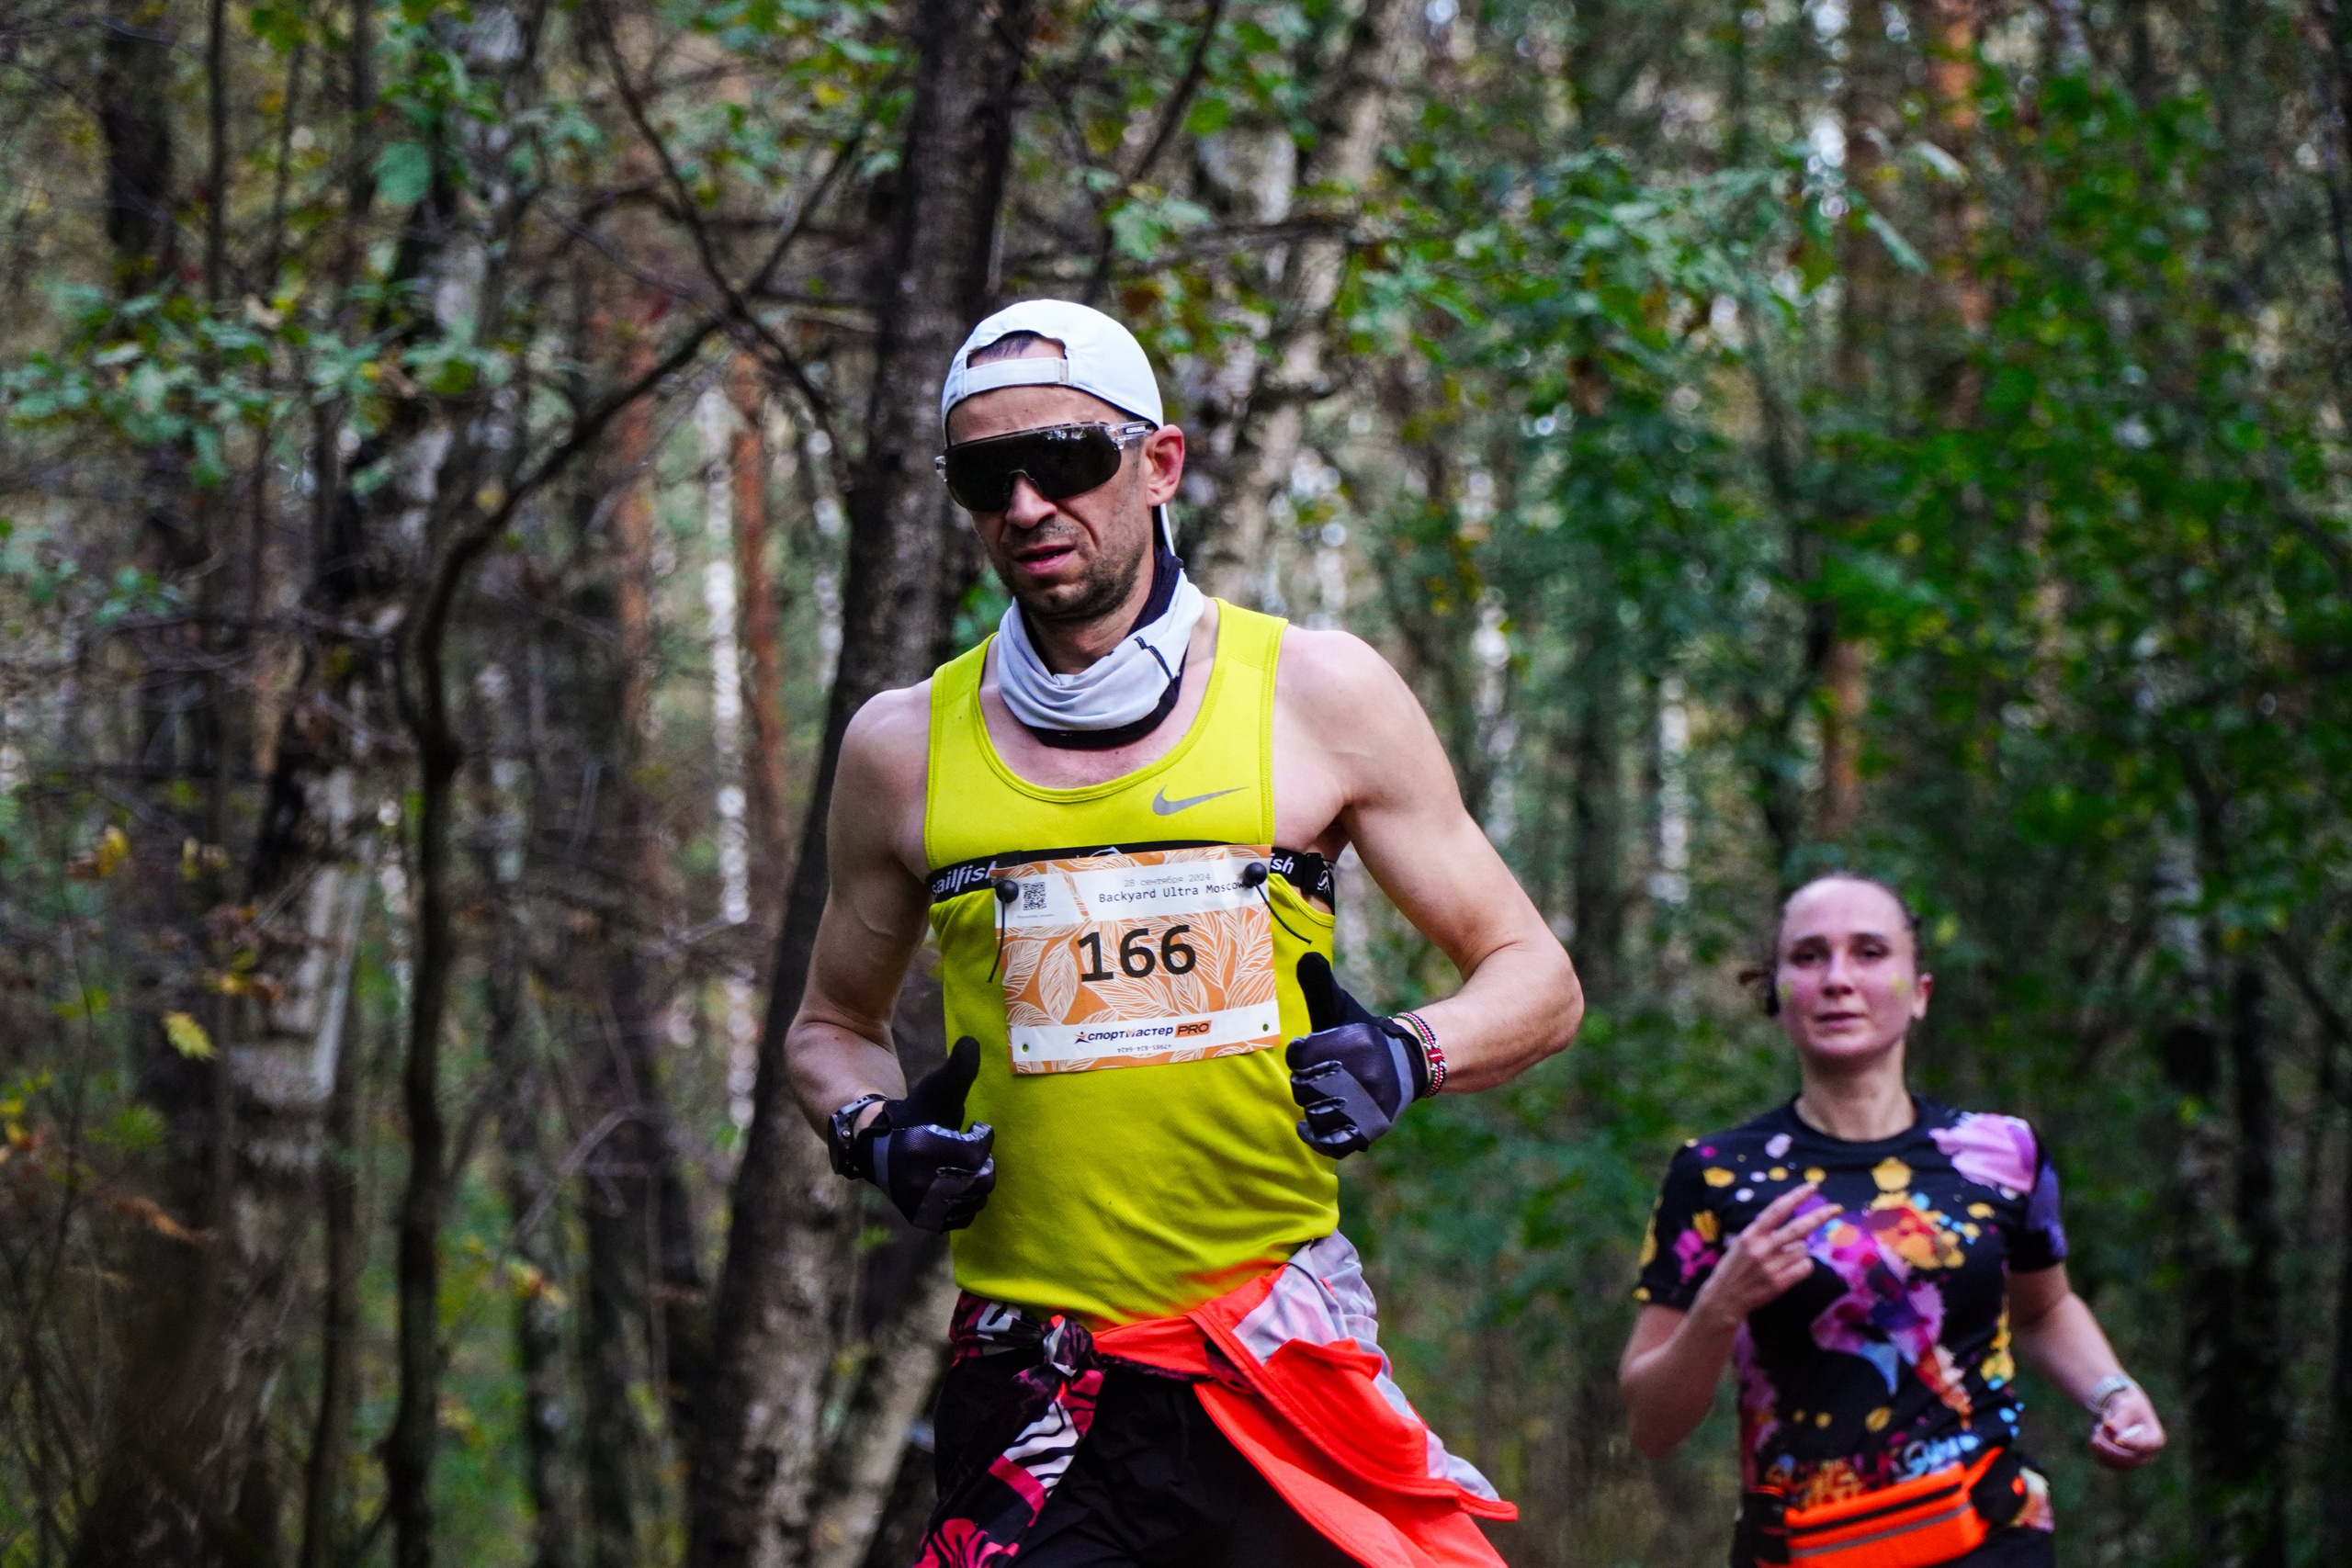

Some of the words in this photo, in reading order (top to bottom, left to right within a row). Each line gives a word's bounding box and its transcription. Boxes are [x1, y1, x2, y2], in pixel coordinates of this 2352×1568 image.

[1124, 879, 1136, 887] 28
[1139, 875, 1183, 886] сентября
[1188, 874, 1211, 883] 2024
[1099, 887, 1157, 903] Backyard
[1162, 886, 1199, 898] Ultra
[1078, 924, 1197, 982] 166
[1177, 1022, 1210, 1036] PRO
